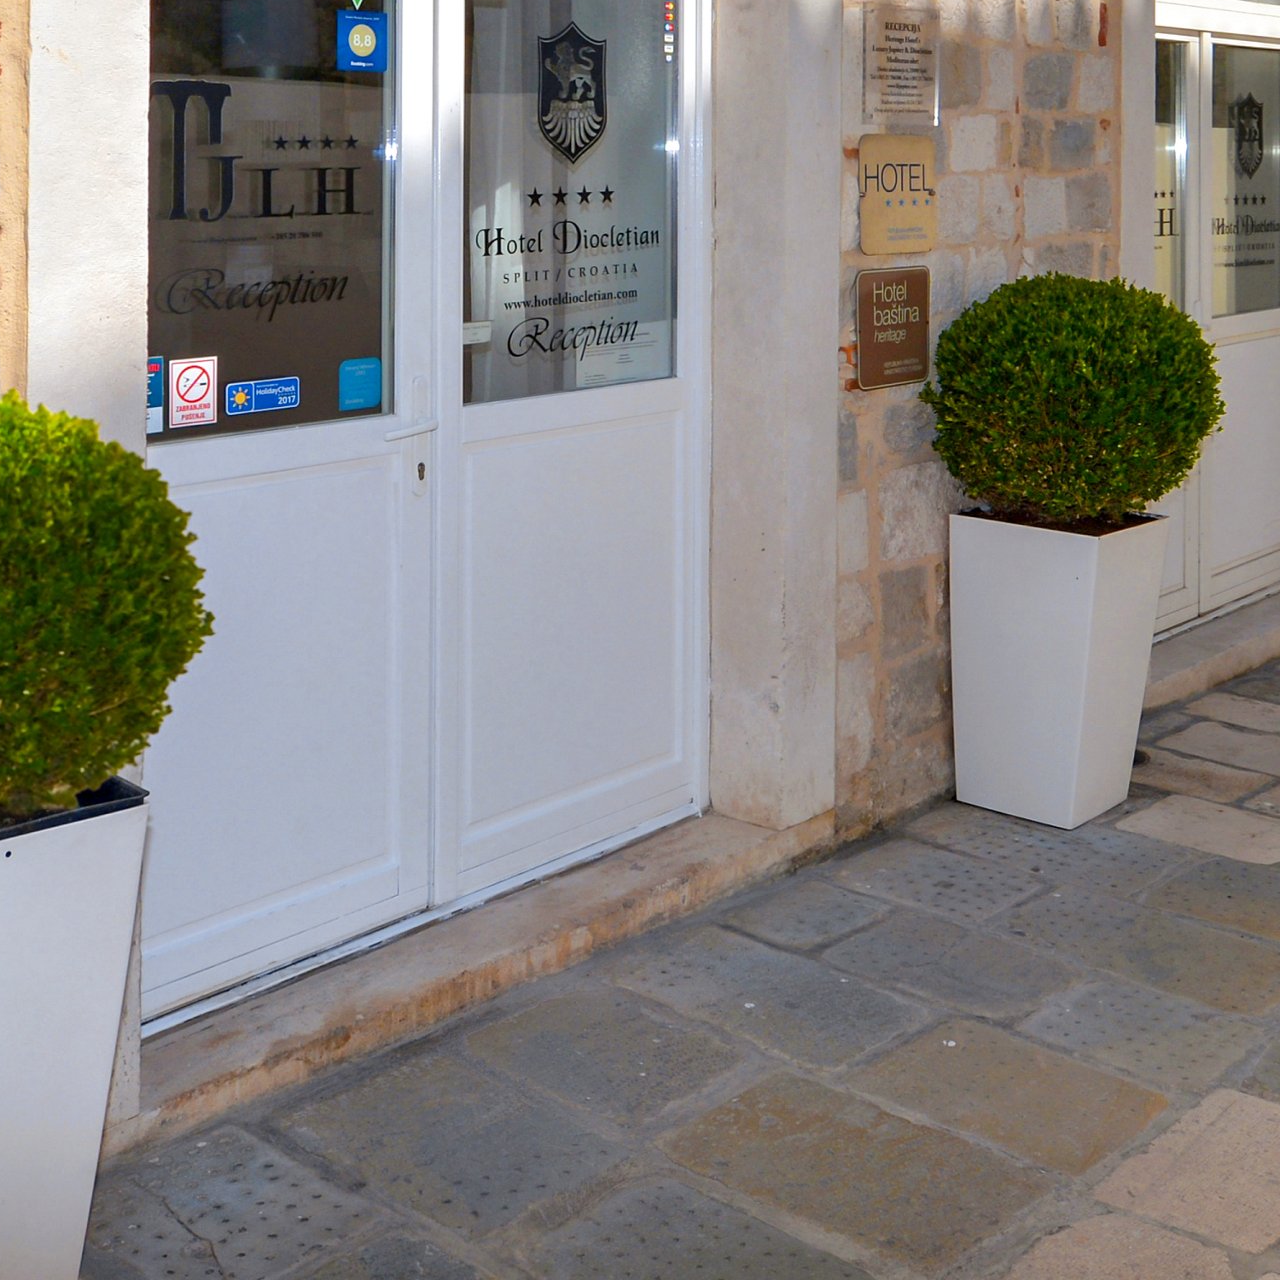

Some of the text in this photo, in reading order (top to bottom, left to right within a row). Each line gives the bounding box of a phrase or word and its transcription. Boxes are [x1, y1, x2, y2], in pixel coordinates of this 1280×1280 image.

[865, 163, 933, 193] HOTEL
[476, 219, 660, 257] Hotel Diocletian
[503, 270, 551, 284] SPLIT
[568, 263, 639, 278] CROATIA
[167, 268, 349, 322] Reception
[504, 288, 638, 310] www.hoteldiocletian.com
[873, 280, 908, 303] Hotel
[873, 302, 920, 326] baština
[507, 316, 639, 361] Reception
[874, 328, 908, 344] heritage
[256, 384, 296, 395] HolidayCheck
[278, 395, 296, 405] 2017
